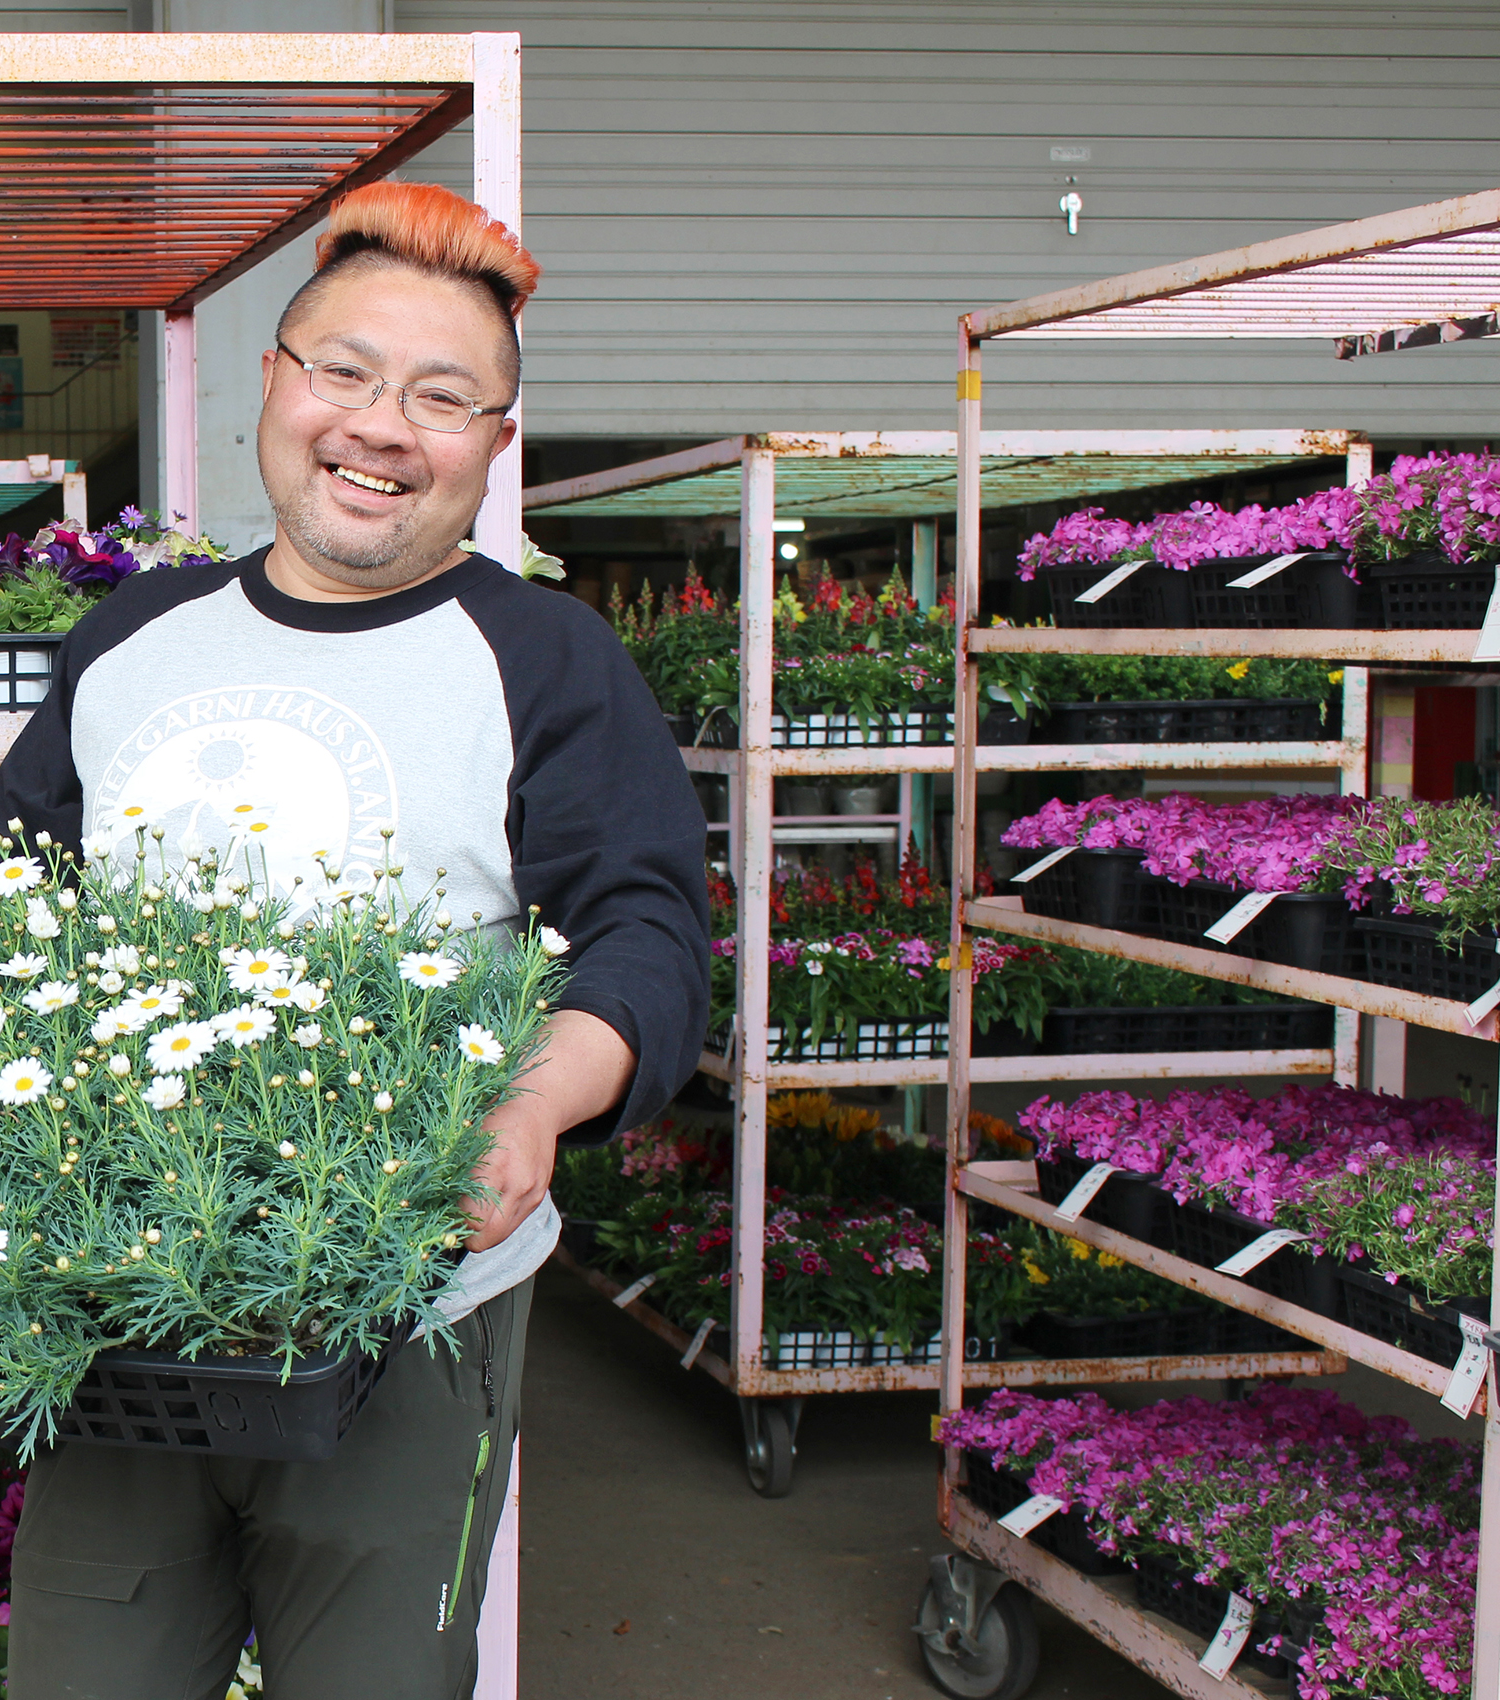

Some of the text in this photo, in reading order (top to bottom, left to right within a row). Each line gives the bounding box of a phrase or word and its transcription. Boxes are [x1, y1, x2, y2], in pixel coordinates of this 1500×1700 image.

[95, 758, 139, 822] TEL
[138, 692, 257, 751] GARNI
[261, 692, 357, 747] HAUS
[342, 789, 388, 906] ANTO
[965, 1336, 997, 1359] 01
[207, 1391, 286, 1437] 01
[436, 1582, 449, 1632] FieldCore
